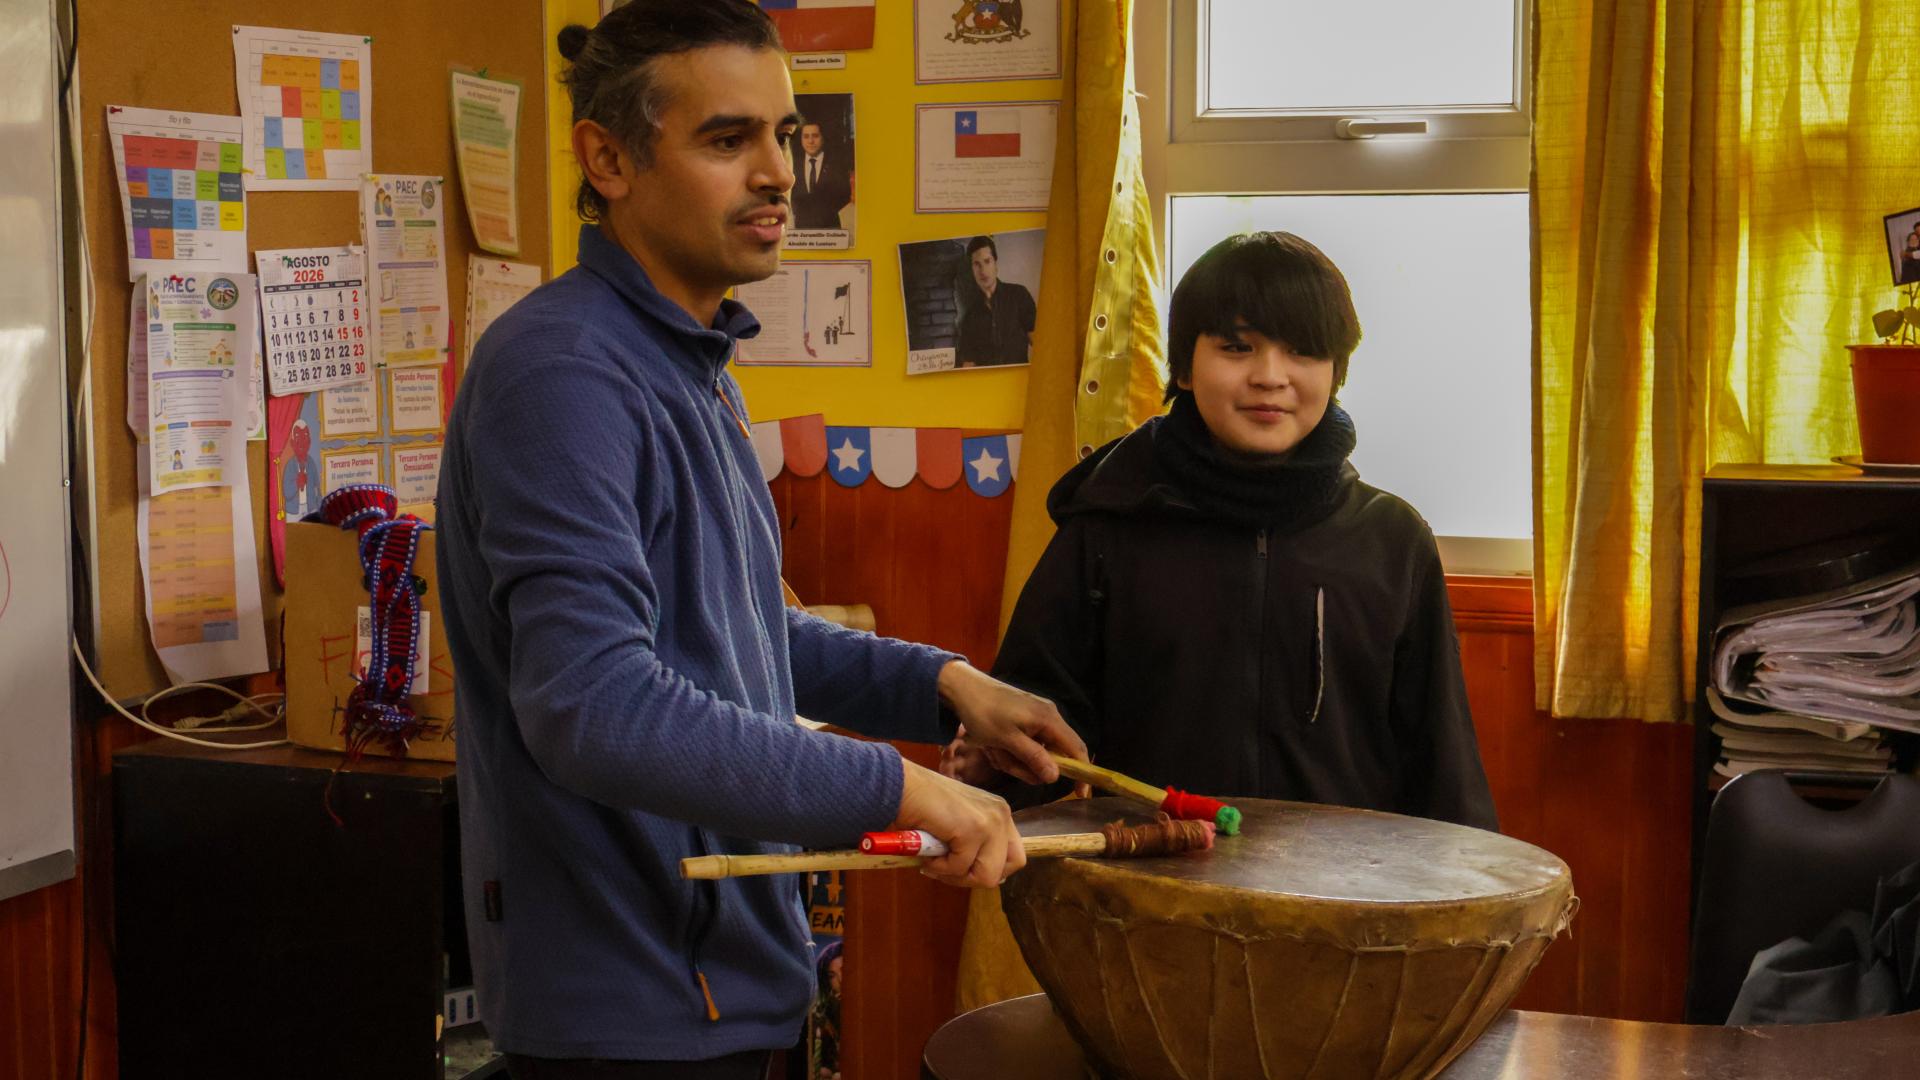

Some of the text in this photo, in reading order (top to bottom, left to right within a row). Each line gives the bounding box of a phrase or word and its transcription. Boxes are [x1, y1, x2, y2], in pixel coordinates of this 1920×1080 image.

[396, 180, 417, 194] PAEC
[286, 255, 330, 269] AGOSTO
[293, 269, 325, 283] 2026
[162, 277, 196, 293] PAEC
[338, 289, 359, 304] 1 2
[271, 308, 359, 329] 3 4 5 6 7 8 9
[271, 326, 363, 348] 10 11 12 13 14 15 16
[273, 344, 365, 366] 17 18 19 20 21 22 23
[287, 369, 298, 383] 25
[300, 368, 310, 382] 26
[312, 366, 323, 380] 27
[325, 364, 337, 378] 28
[340, 363, 352, 376] 29
[354, 361, 366, 375] 30
